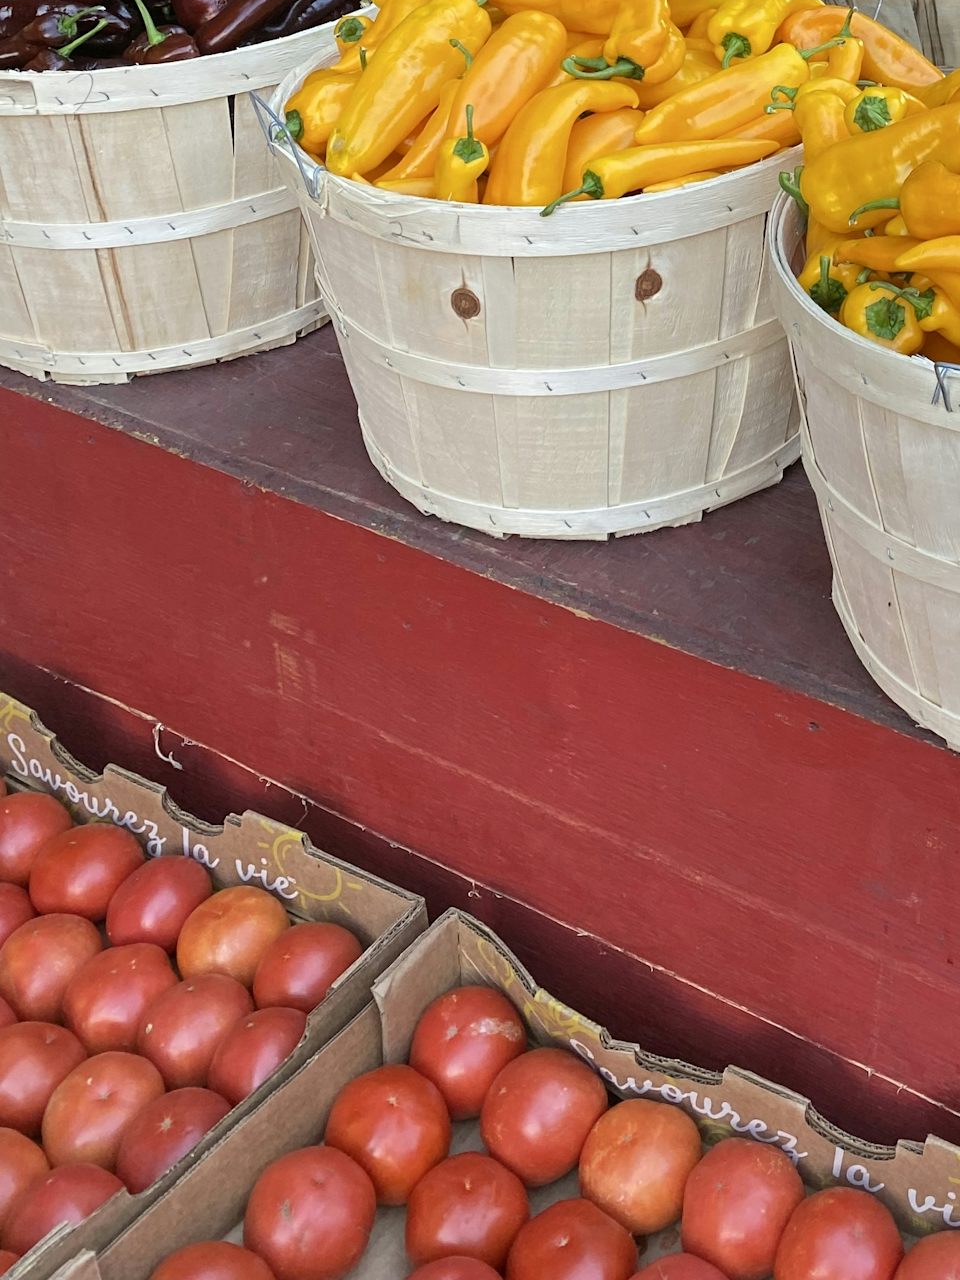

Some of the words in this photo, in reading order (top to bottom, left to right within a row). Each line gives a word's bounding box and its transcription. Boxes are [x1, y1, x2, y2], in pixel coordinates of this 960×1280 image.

[7, 732, 166, 858] Savourez
[182, 826, 220, 871] la
[569, 1037, 808, 1165] Savourez
[832, 1146, 885, 1195] la
